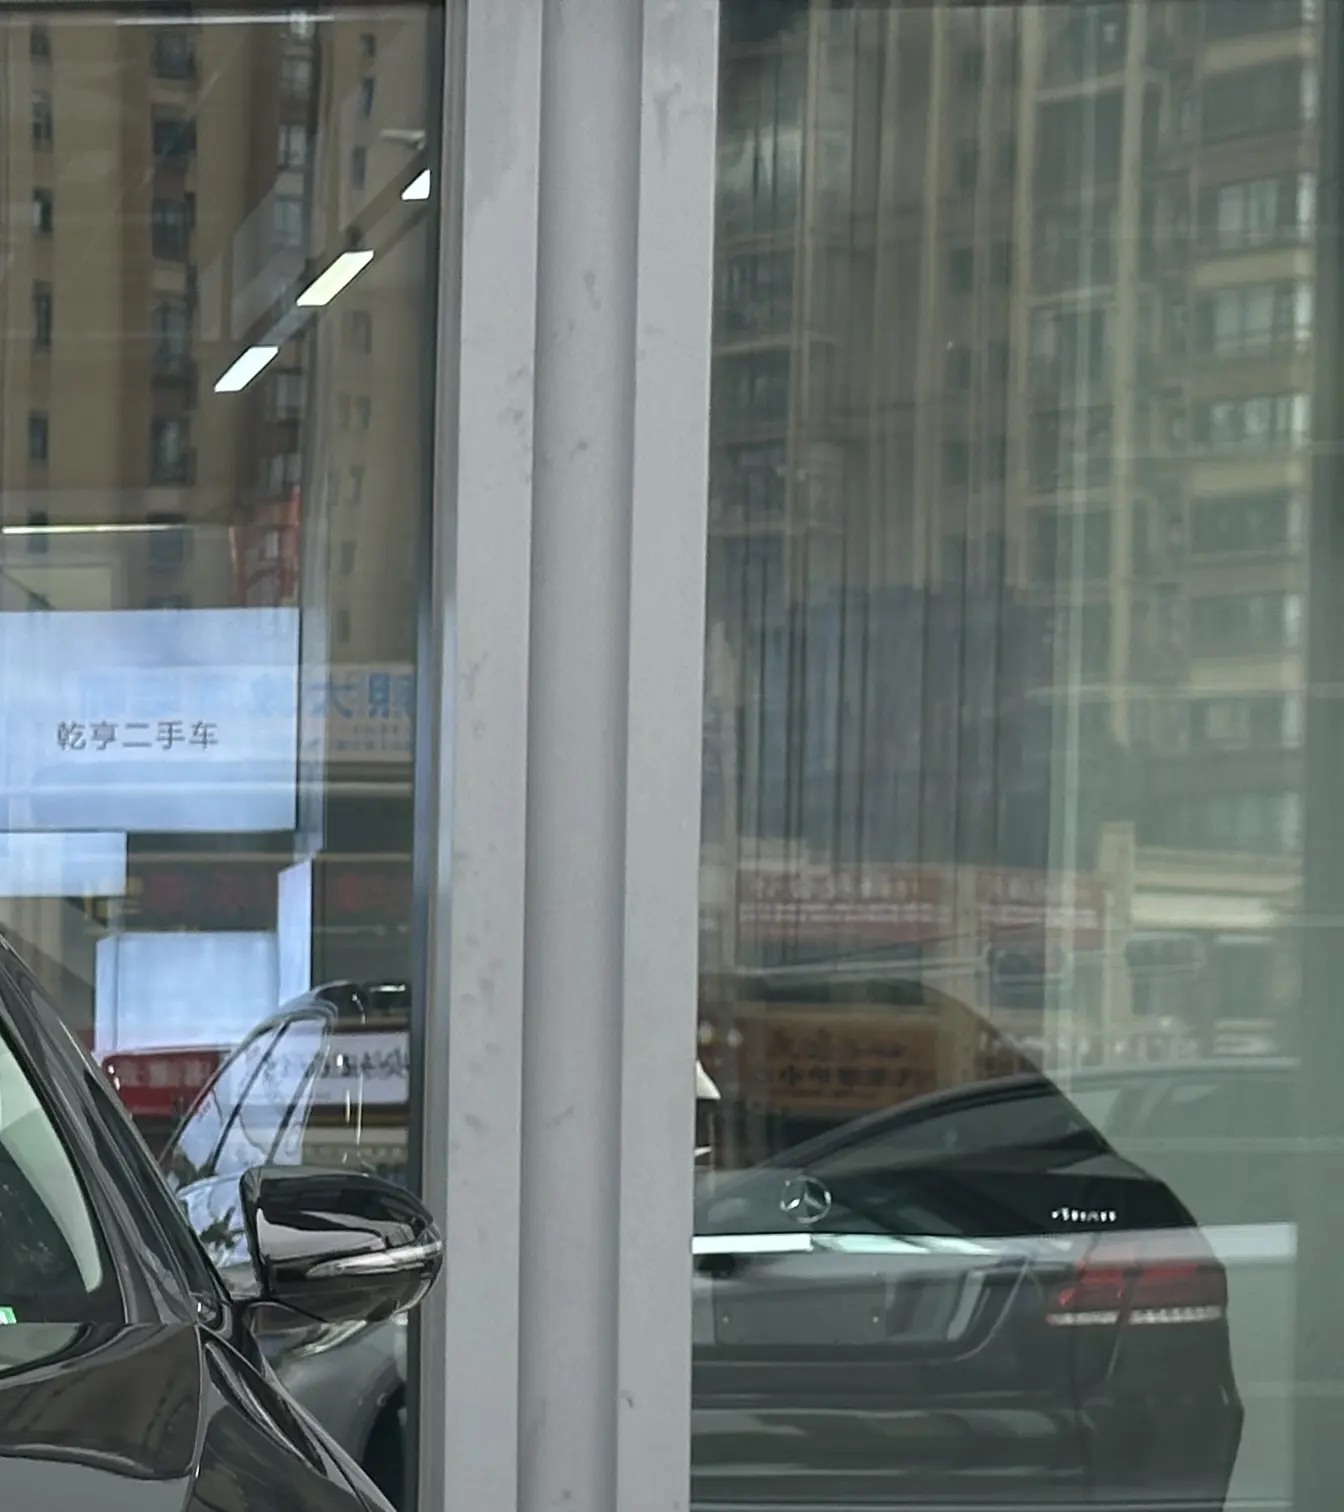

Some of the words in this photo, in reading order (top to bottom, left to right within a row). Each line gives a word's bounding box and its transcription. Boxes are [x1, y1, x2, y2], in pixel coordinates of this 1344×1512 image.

[56, 720, 218, 750] 乾亨二手车
